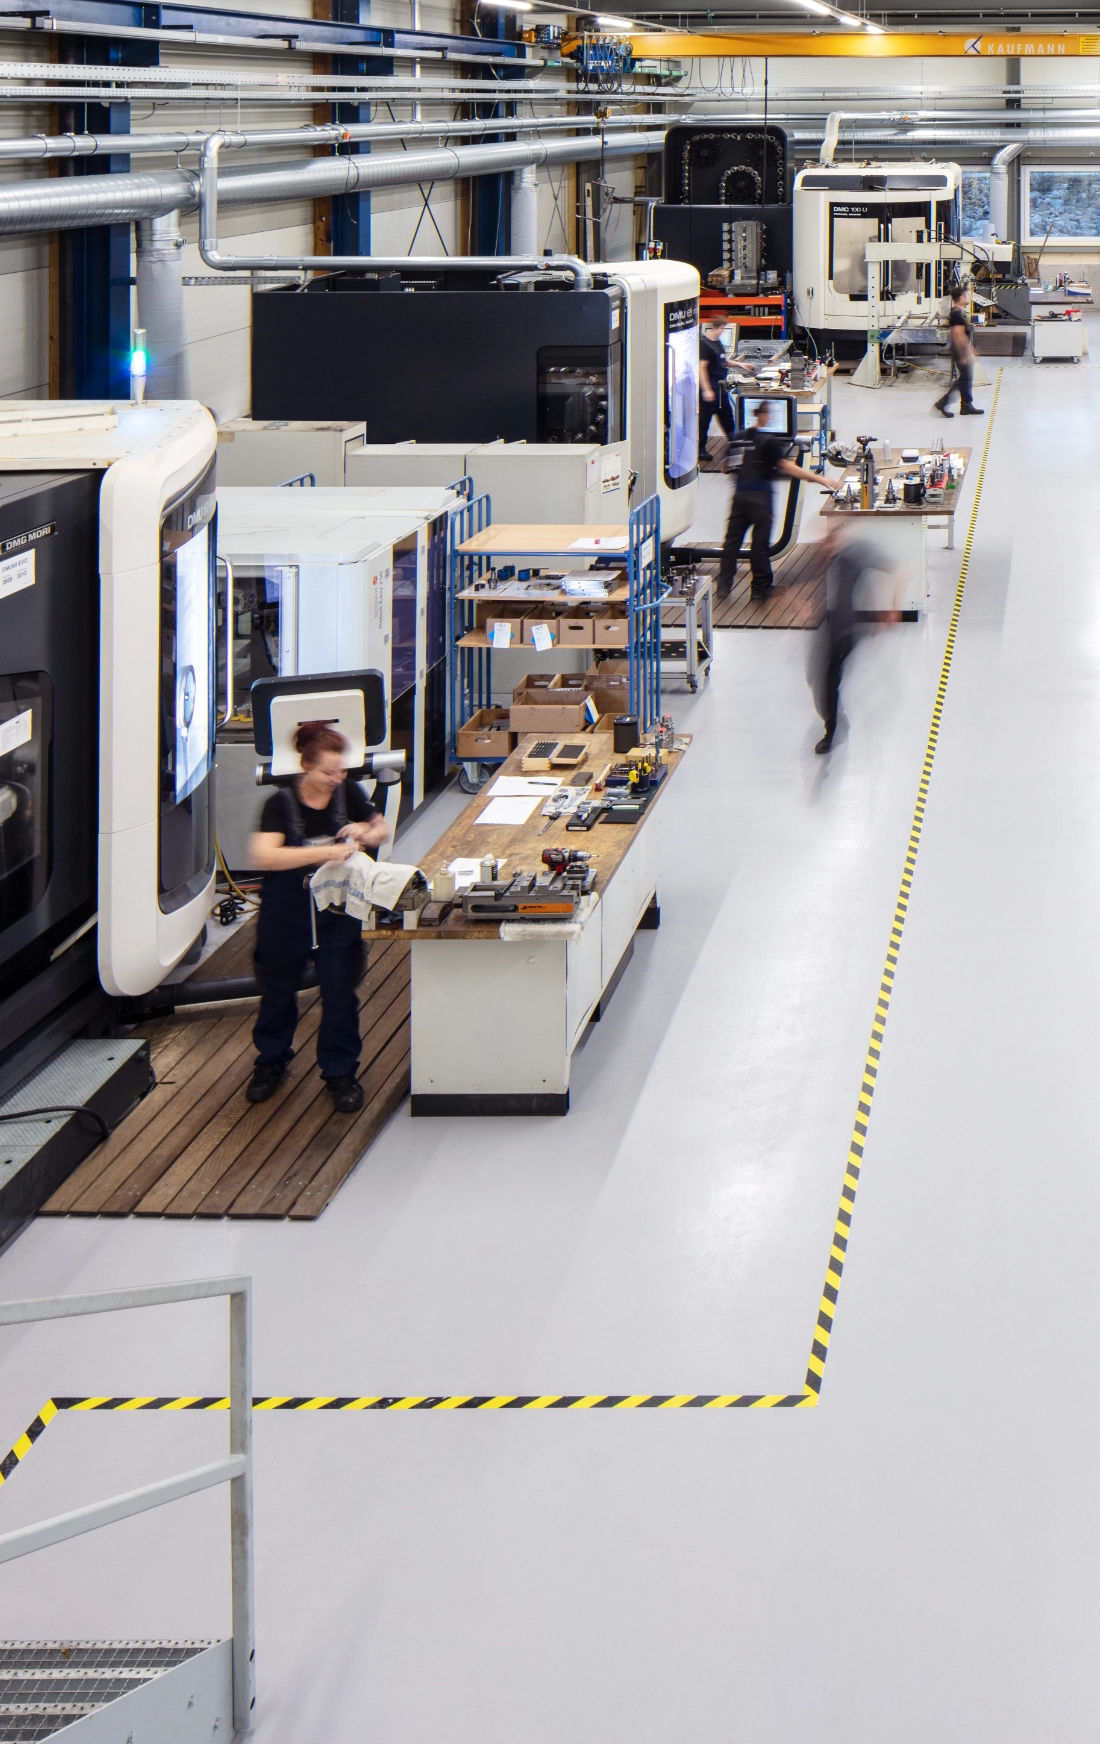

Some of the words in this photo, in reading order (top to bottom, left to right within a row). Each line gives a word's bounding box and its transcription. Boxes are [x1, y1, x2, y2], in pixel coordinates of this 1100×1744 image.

[987, 43, 1066, 55] KAUFMANN
[669, 310, 686, 322] DMU
[187, 505, 204, 530] DMU
[6, 535, 28, 551] DMG
[28, 525, 52, 542] MORI
